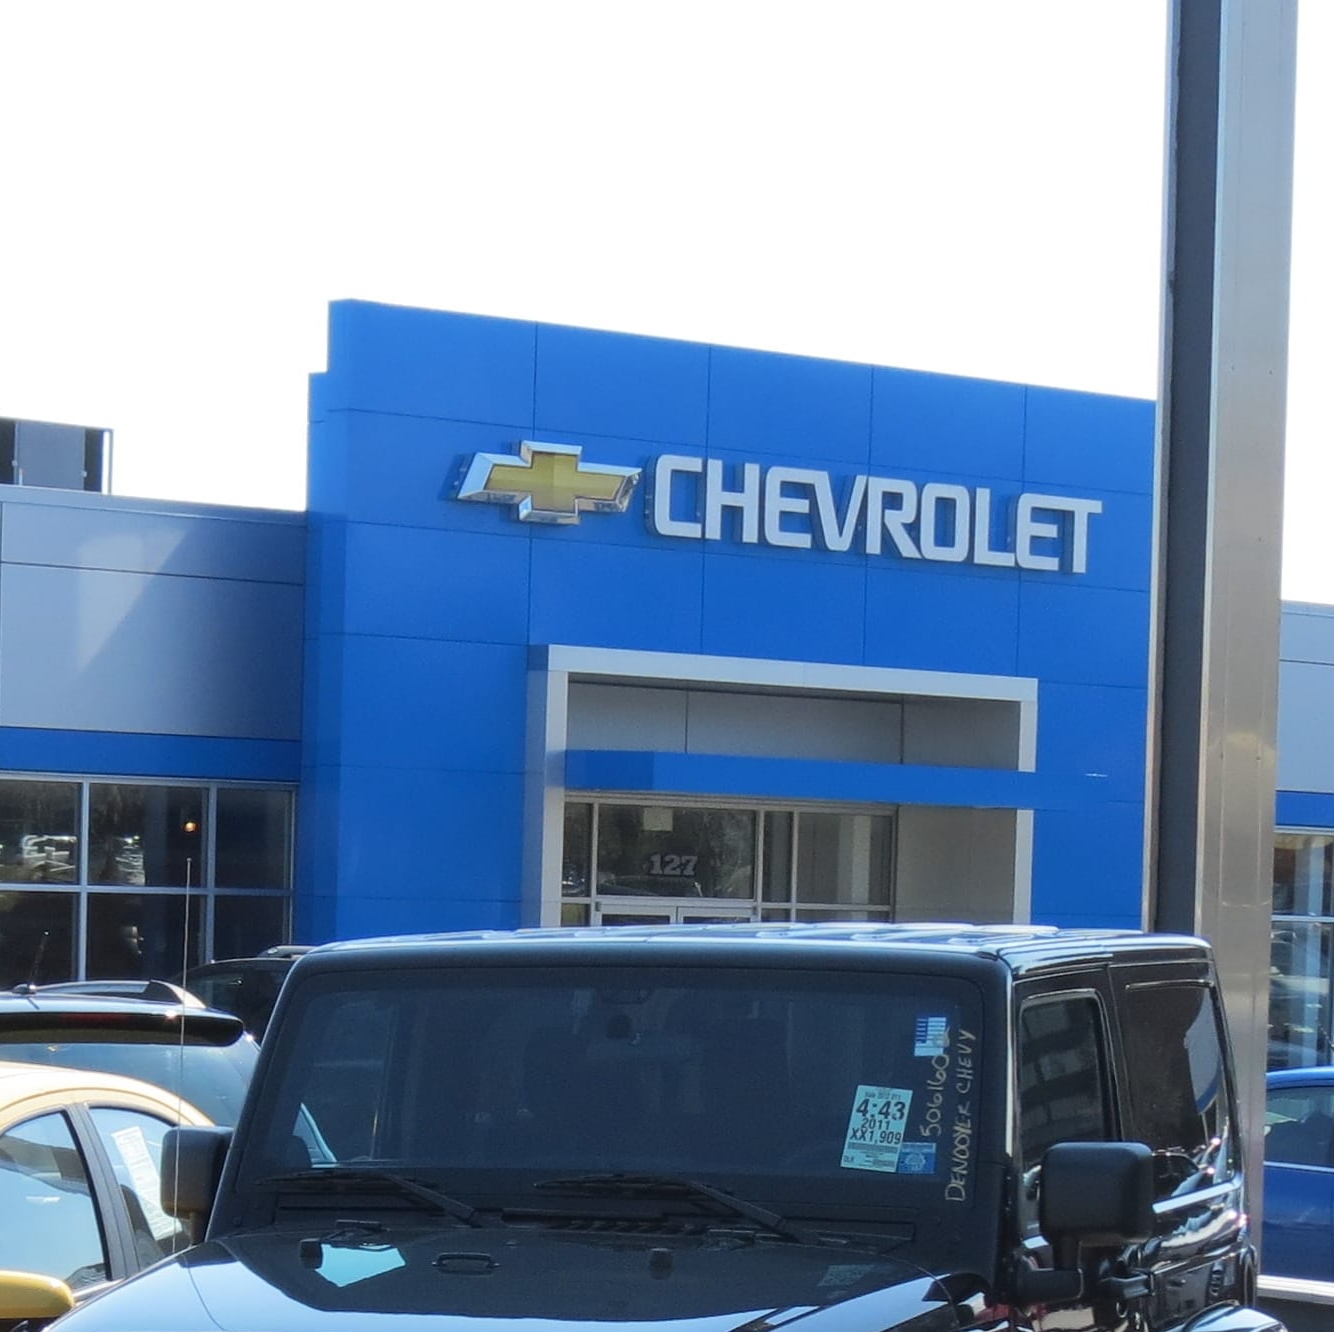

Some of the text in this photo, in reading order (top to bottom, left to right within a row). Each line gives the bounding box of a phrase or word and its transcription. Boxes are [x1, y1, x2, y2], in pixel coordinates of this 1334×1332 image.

[653, 453, 1103, 574] CHEVROLET
[650, 853, 699, 876] 127
[956, 1029, 976, 1095] CHEVY
[860, 1117, 891, 1131] 2011
